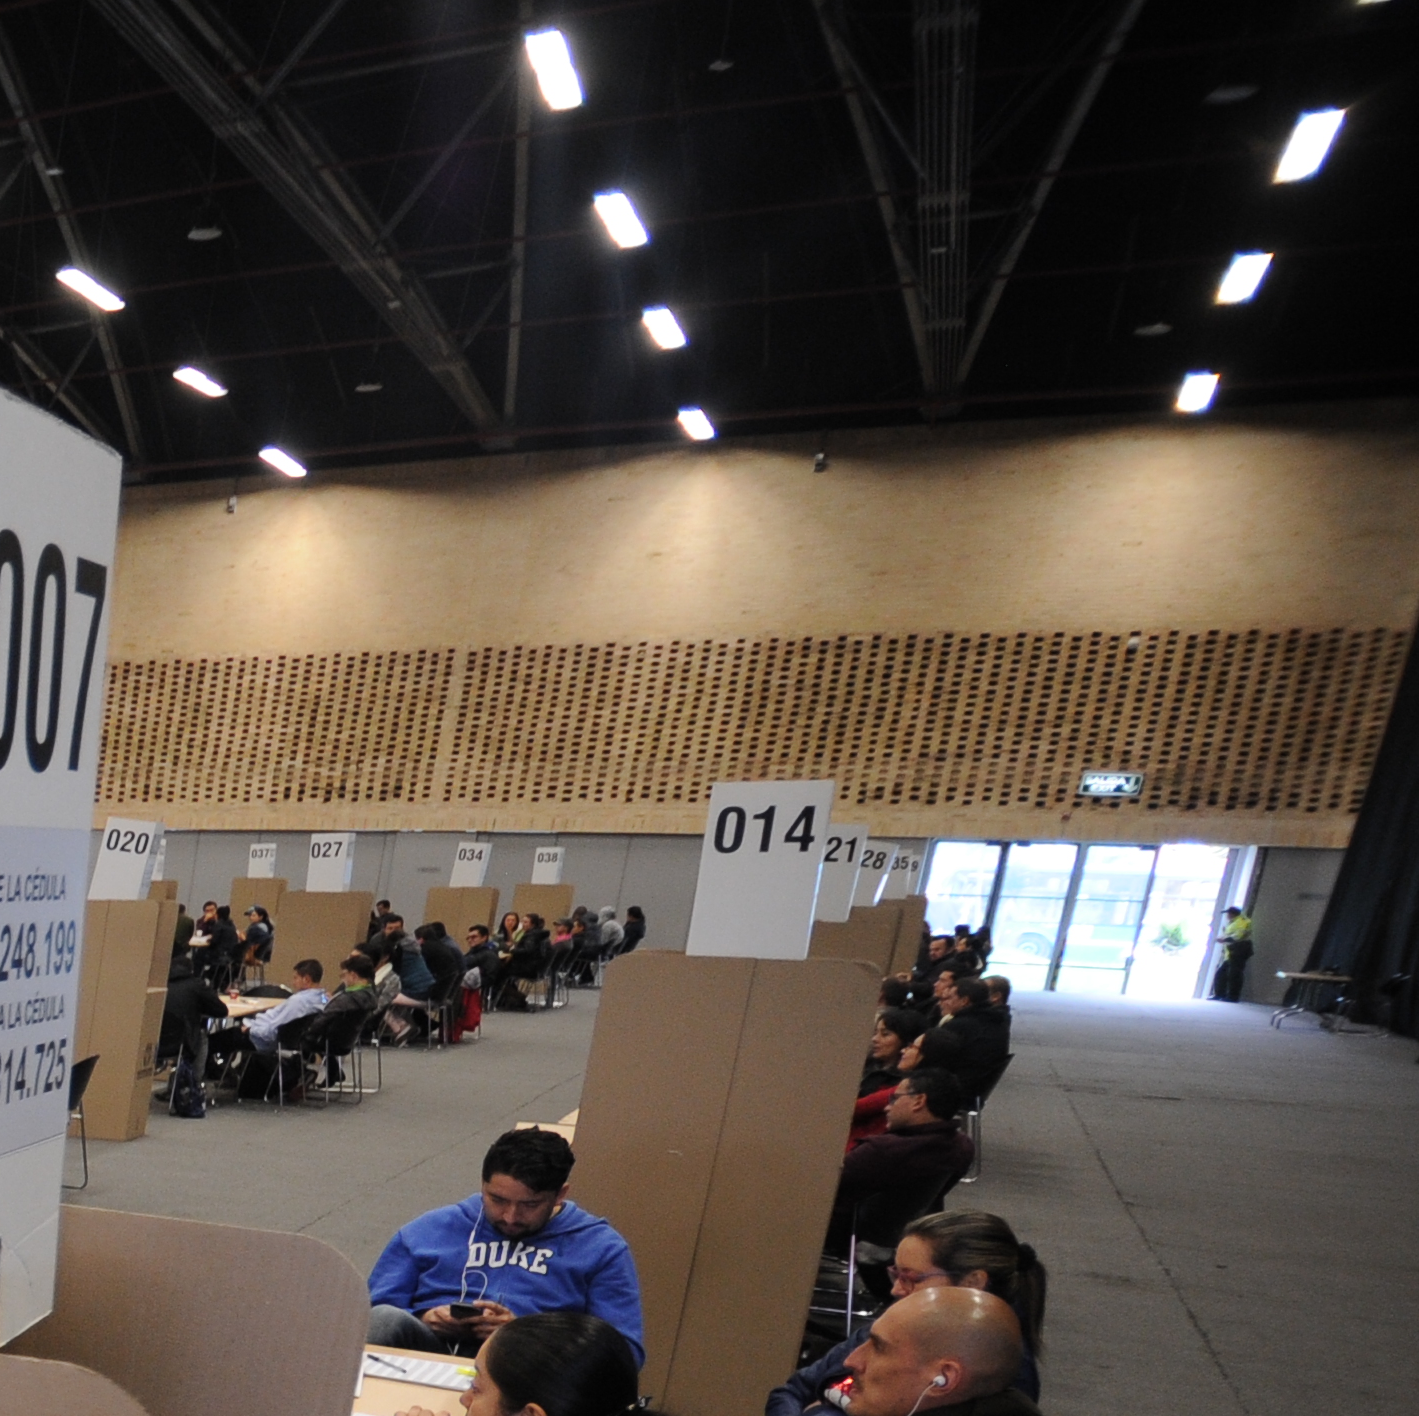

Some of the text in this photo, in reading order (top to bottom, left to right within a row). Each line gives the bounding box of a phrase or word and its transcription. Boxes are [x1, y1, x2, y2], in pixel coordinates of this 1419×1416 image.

[106, 828, 150, 855] 020
[714, 805, 816, 854] 014
[251, 848, 270, 859] 037
[311, 841, 343, 859] 027
[457, 848, 484, 861] 034
[537, 852, 558, 863] 038
[824, 836, 858, 863] 21
[860, 849, 887, 870] 28
[892, 855, 910, 871] 35
[7, 874, 22, 902] LA
[24, 867, 66, 902] CÉDULA
[7, 1001, 23, 1030] LA
[24, 991, 66, 1027] CÉDULA
[465, 1240, 553, 1275] DUKE
